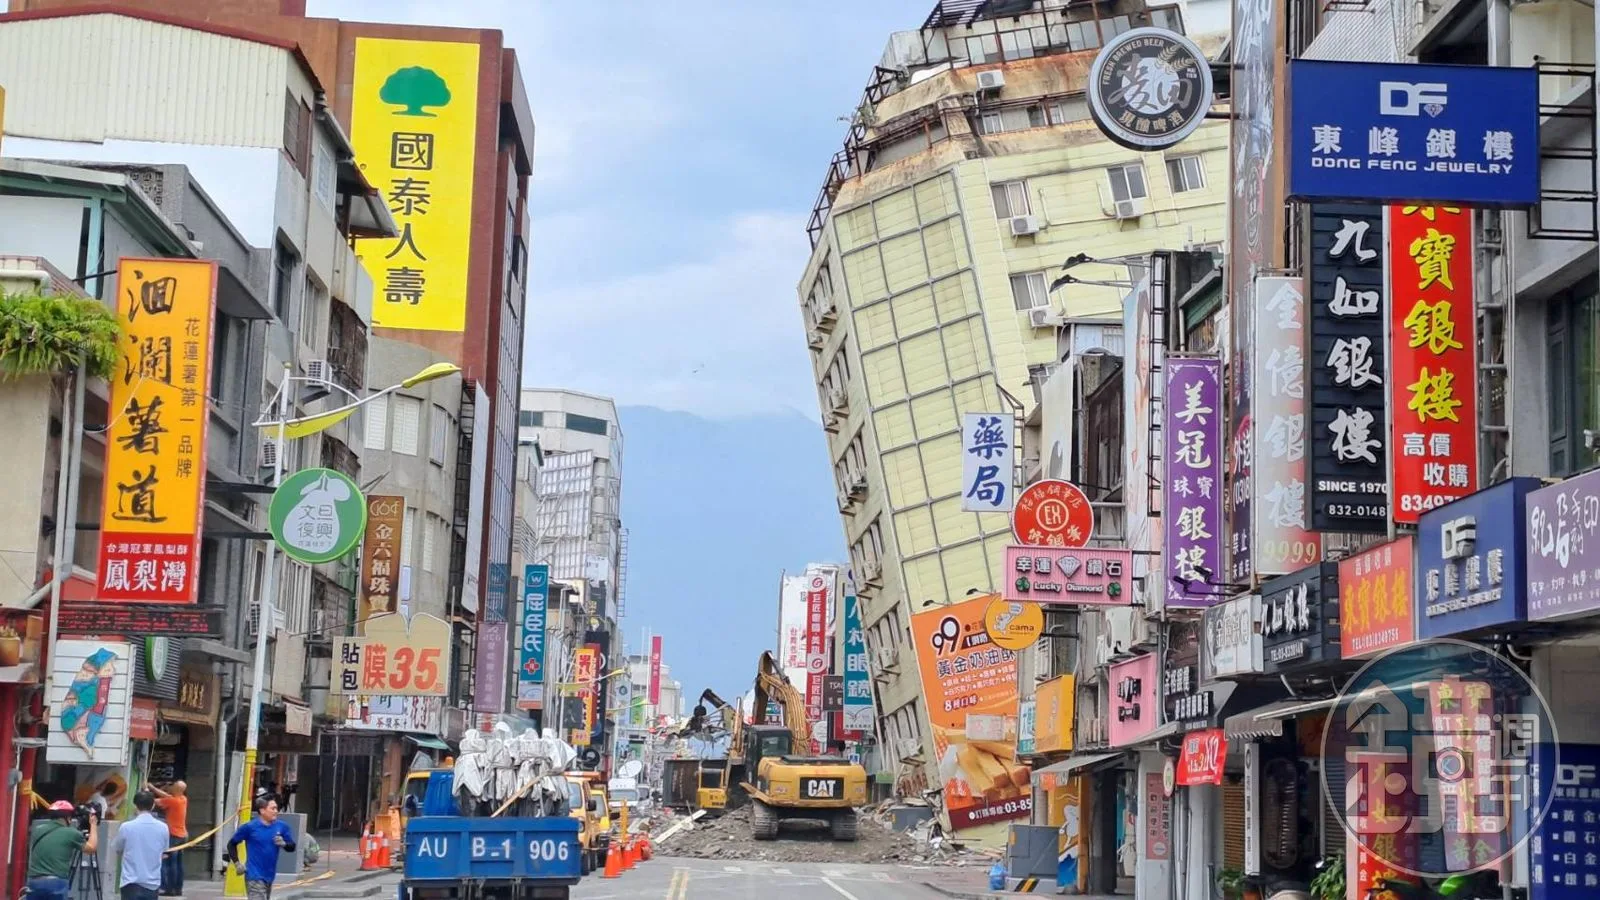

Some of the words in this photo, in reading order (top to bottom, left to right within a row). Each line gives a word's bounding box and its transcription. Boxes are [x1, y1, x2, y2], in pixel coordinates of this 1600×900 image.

[1113, 39, 1143, 62] BREWED
[1143, 38, 1164, 47] BEER
[1380, 81, 1447, 116] DF
[1311, 124, 1514, 161] 東峰銀樓
[1311, 157, 1361, 169] DONG
[1367, 159, 1417, 171] FENG
[1423, 161, 1513, 175] JEWELRY
[383, 131, 434, 306] 國泰人壽
[1327, 218, 1383, 464] 九如銀樓
[112, 269, 178, 523] 洄瀾薯道
[175, 318, 201, 479] 花蓮薯第一品牌
[1174, 380, 1213, 469] 美冠
[1403, 432, 1451, 457] 高價
[966, 416, 1008, 507] 藥局
[1423, 462, 1469, 488] 收購
[1173, 476, 1214, 499] 珠寶
[1318, 480, 1356, 494] SINCE
[1359, 481, 1388, 495] 1970
[299, 504, 334, 521] 文旦
[1328, 503, 1387, 517] 832-0148
[1401, 494, 1462, 511] 8349
[298, 522, 333, 539] 復興
[1174, 506, 1213, 584] 銀樓
[1261, 540, 1317, 564] 9999
[103, 559, 187, 593] 鳳梨灣
[1016, 556, 1052, 574] 幸運
[1087, 558, 1122, 577] 鑽石
[1034, 582, 1062, 594] Lucky
[1066, 582, 1104, 593] Diamond
[523, 593, 545, 653] 屈臣氏
[1009, 624, 1035, 632] cama
[932, 616, 960, 656] 99
[1557, 764, 1596, 785] DF
[807, 779, 836, 798] CAT
[418, 837, 448, 858] AU
[529, 839, 569, 861] 906
[1564, 852, 1597, 866] 白金
